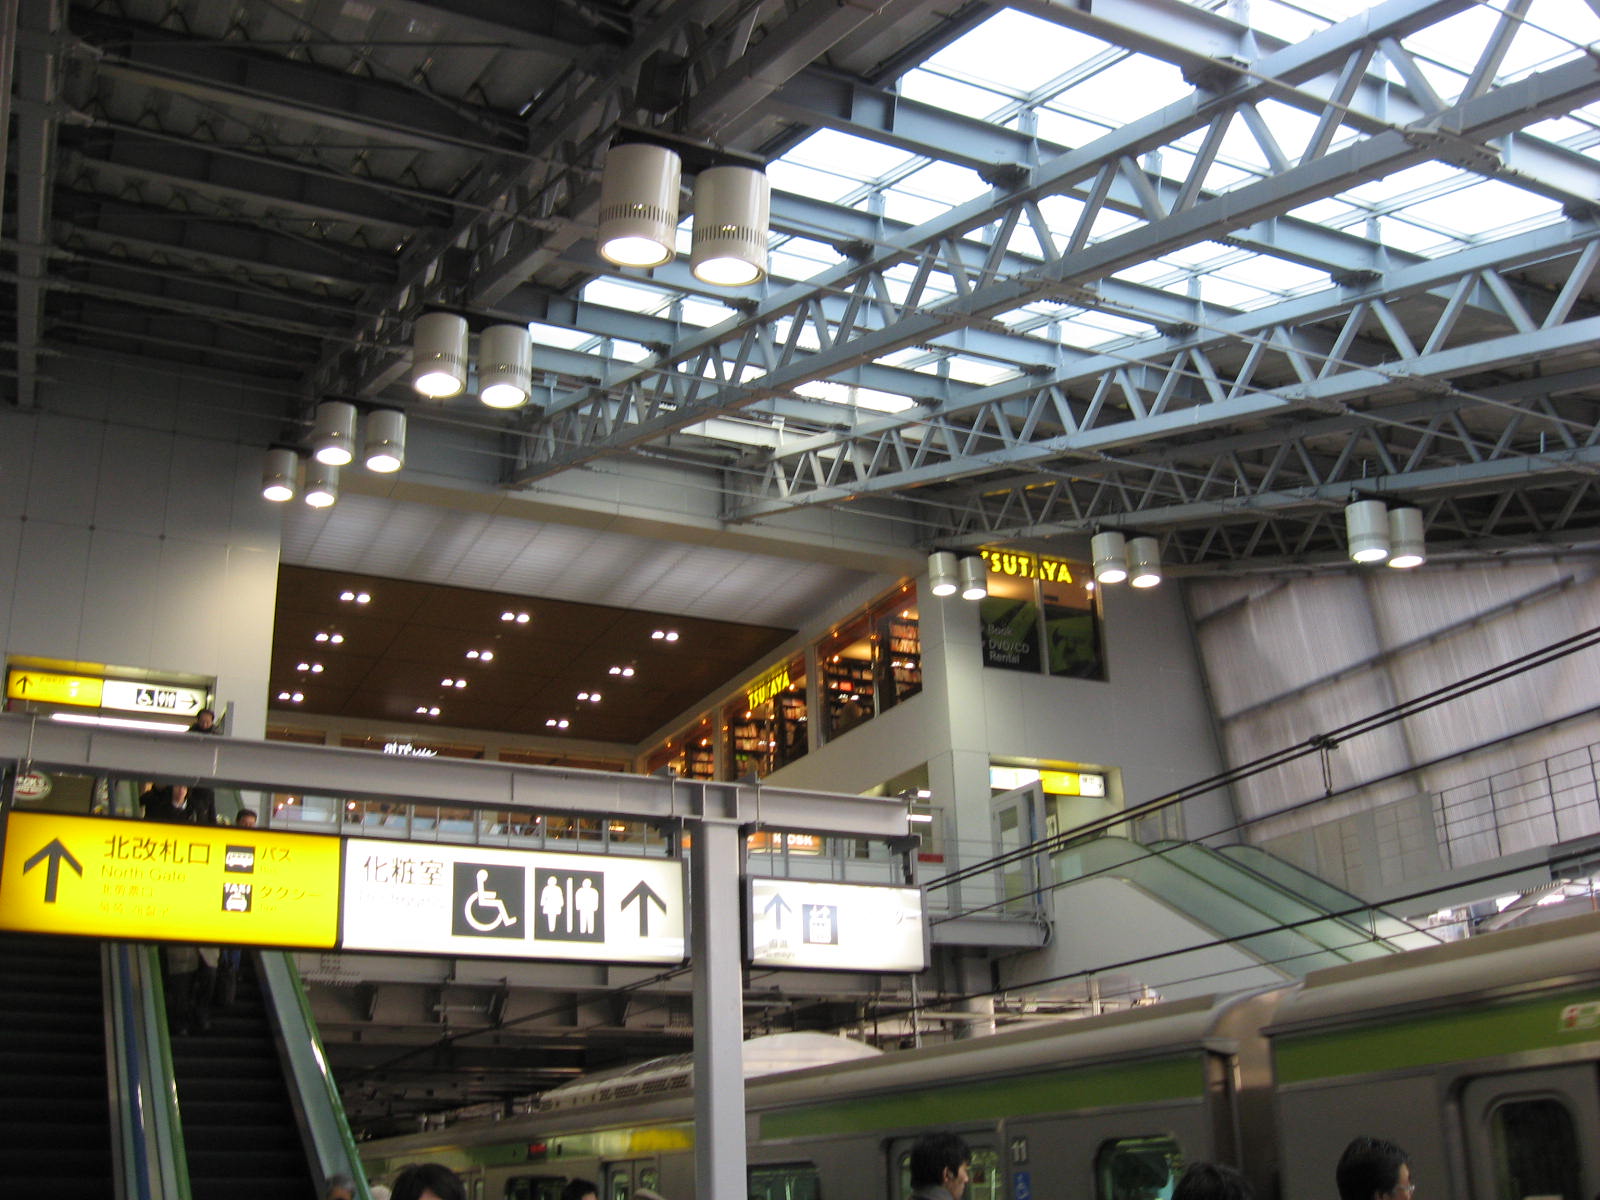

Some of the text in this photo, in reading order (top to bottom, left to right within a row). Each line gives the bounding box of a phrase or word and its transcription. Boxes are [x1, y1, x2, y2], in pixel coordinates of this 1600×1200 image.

[989, 639, 1030, 654] DVD/CD
[989, 652, 1020, 665] Rental
[748, 670, 791, 711] TSUTAYA
[772, 832, 814, 846] KOSK
[104, 834, 212, 865] 北改札口
[260, 846, 292, 862] バス
[101, 864, 187, 882] North Gate
[363, 855, 444, 887] 化粧室
[1011, 1139, 1027, 1162] 11
